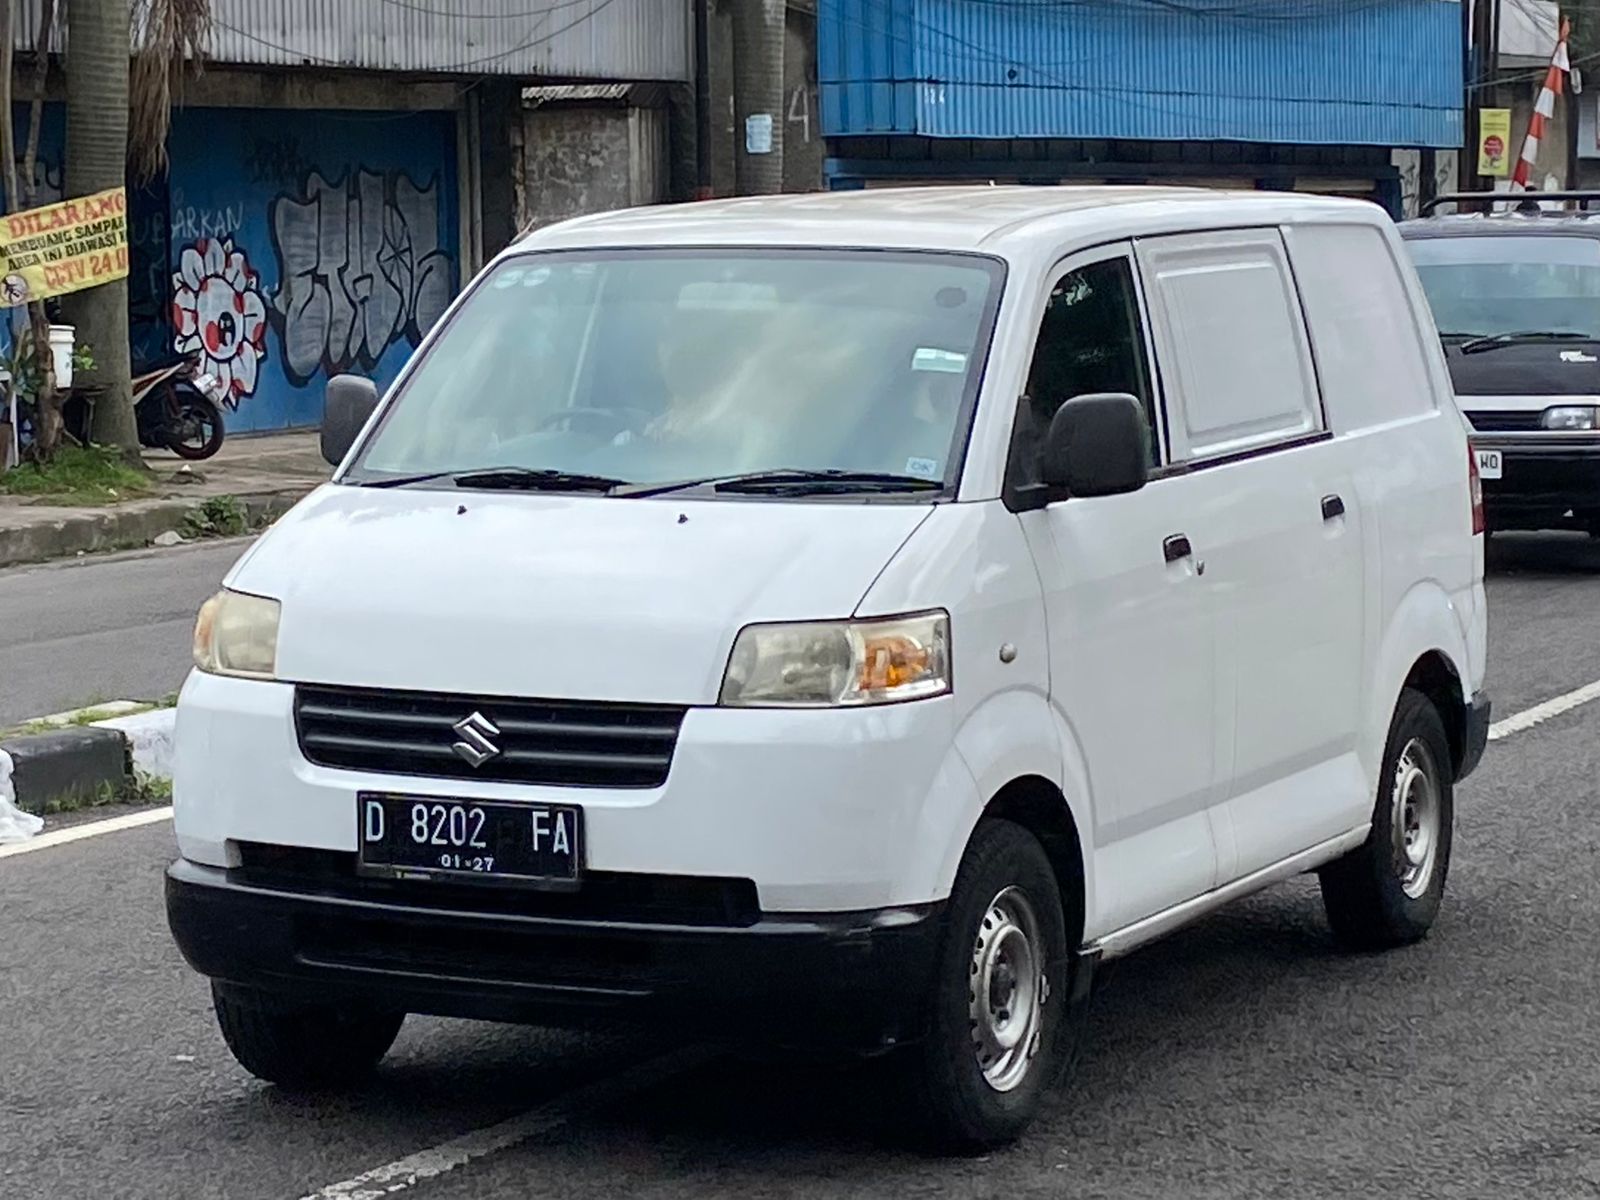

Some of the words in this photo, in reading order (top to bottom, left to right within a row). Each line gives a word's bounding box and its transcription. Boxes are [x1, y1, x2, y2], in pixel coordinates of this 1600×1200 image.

[788, 86, 810, 143] 4
[8, 253, 40, 271] AREA
[43, 249, 62, 263] INI
[65, 234, 117, 257] DIAWASI
[43, 258, 85, 290] CCTV
[89, 252, 112, 277] 24
[365, 801, 385, 842] D
[411, 803, 487, 849] 8202
[532, 810, 570, 855] FA
